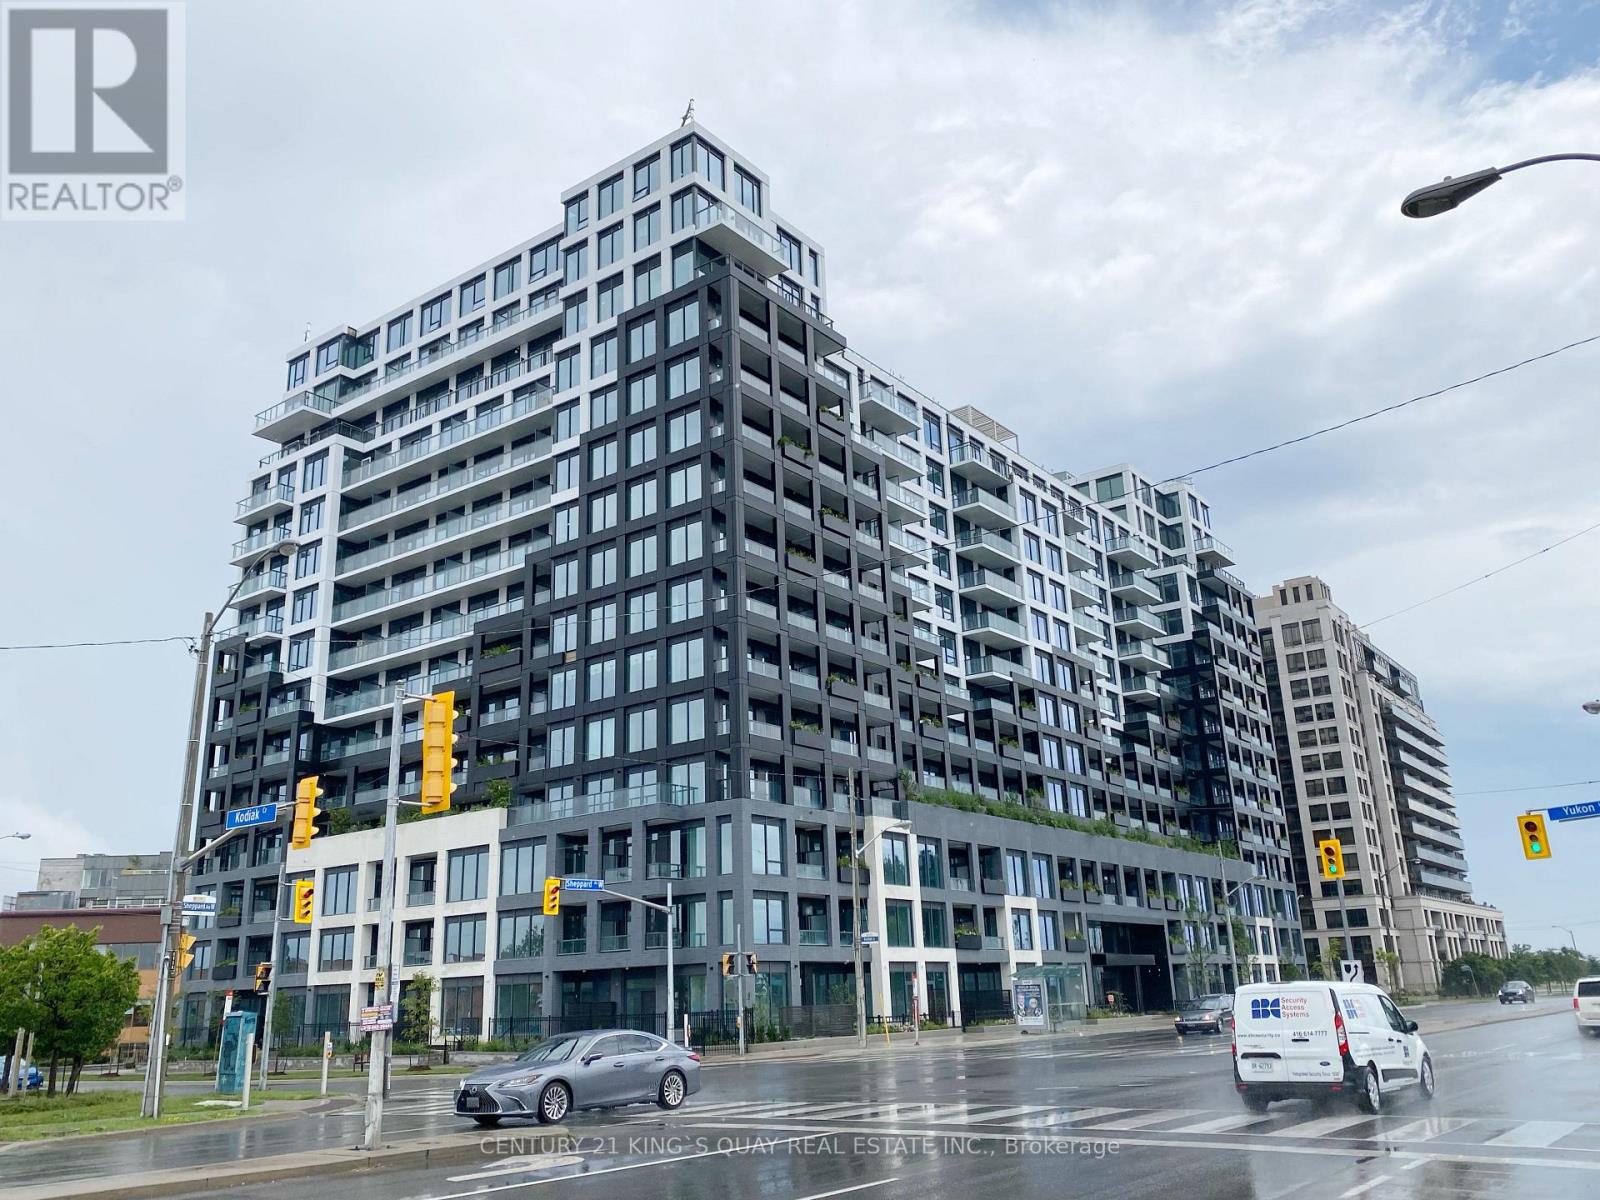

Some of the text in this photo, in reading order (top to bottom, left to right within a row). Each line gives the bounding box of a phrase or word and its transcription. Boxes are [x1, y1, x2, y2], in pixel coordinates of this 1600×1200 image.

[1562, 804, 1596, 816] Yukon
[235, 807, 260, 824] Kodiak
[566, 879, 592, 889] Sheppard
[1281, 996, 1308, 1005] Security
[1281, 1010, 1310, 1020] Systems
